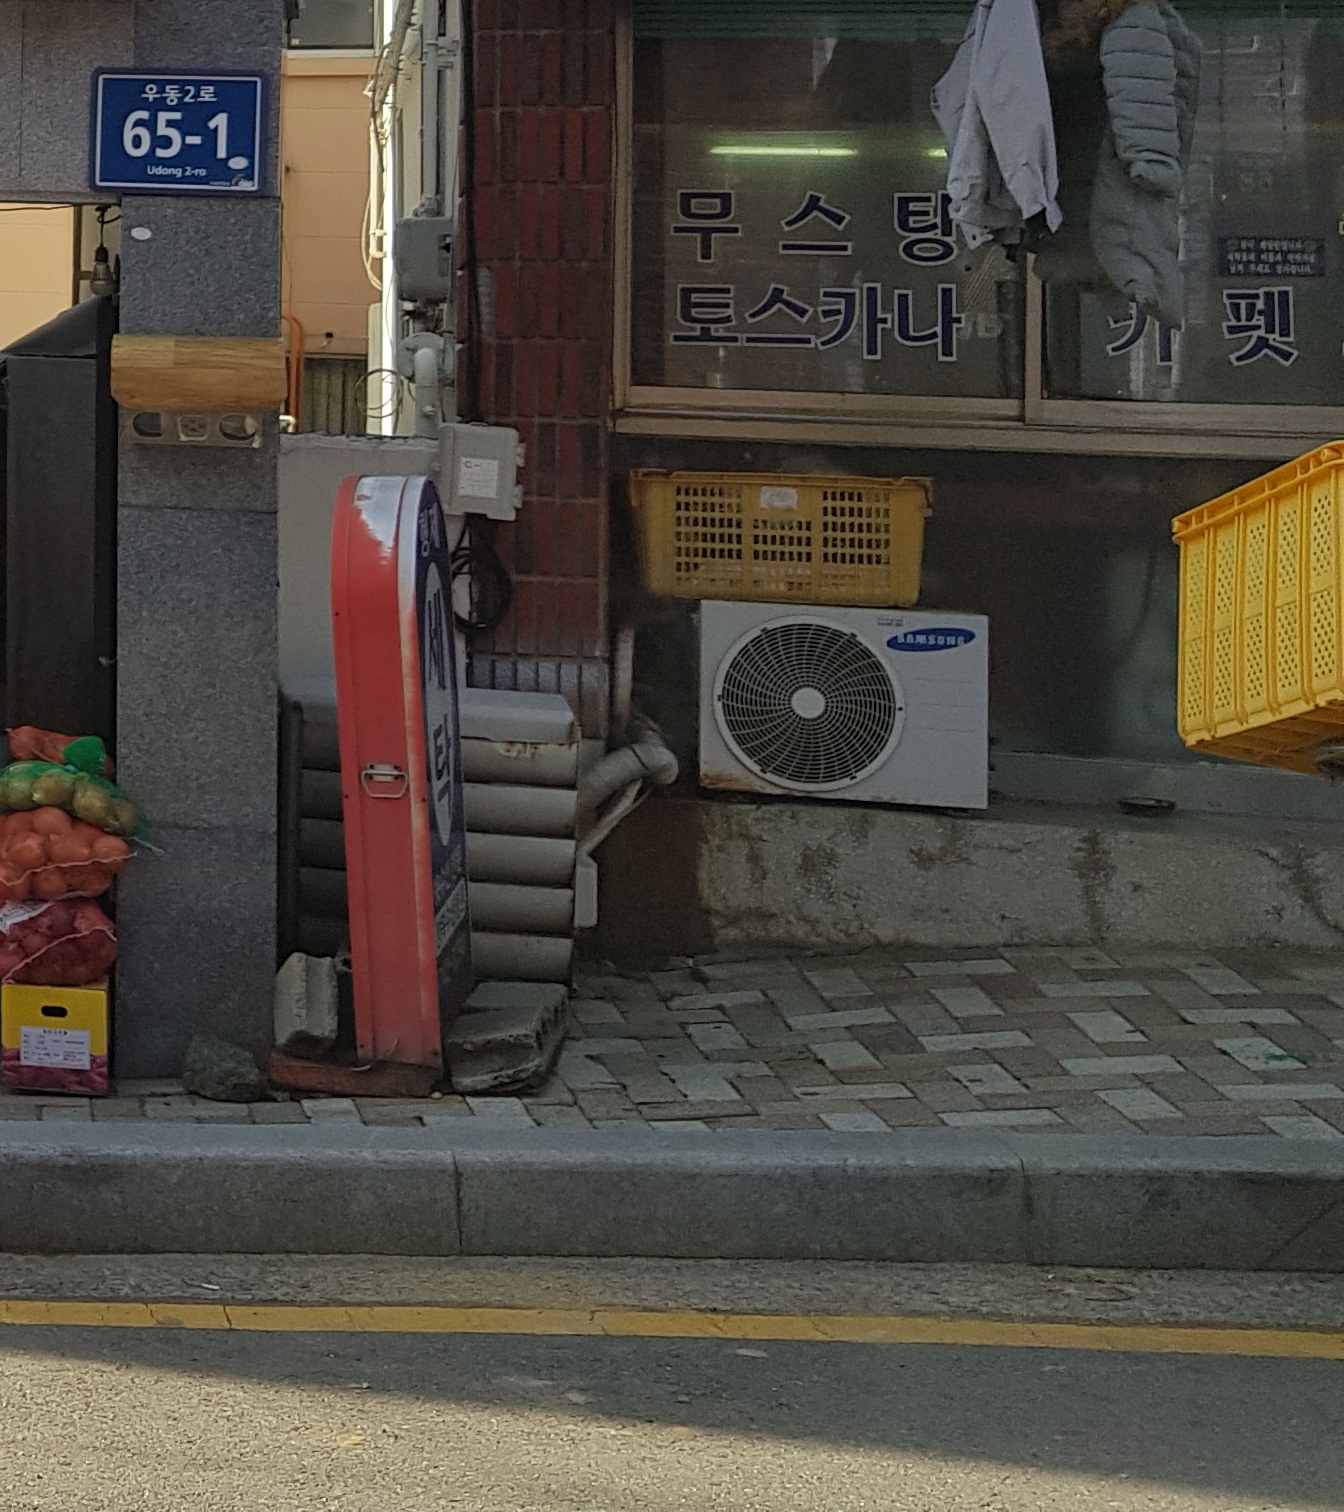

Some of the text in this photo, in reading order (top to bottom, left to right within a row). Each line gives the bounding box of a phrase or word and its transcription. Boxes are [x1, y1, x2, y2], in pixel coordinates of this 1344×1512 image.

[141, 83, 218, 106] 우동2로
[123, 110, 229, 160] 65-1
[147, 165, 207, 179] Udong 2-ro
[670, 189, 959, 266] 무스탕
[670, 281, 963, 362] 토스카나
[896, 632, 965, 646] SAMSUNG
